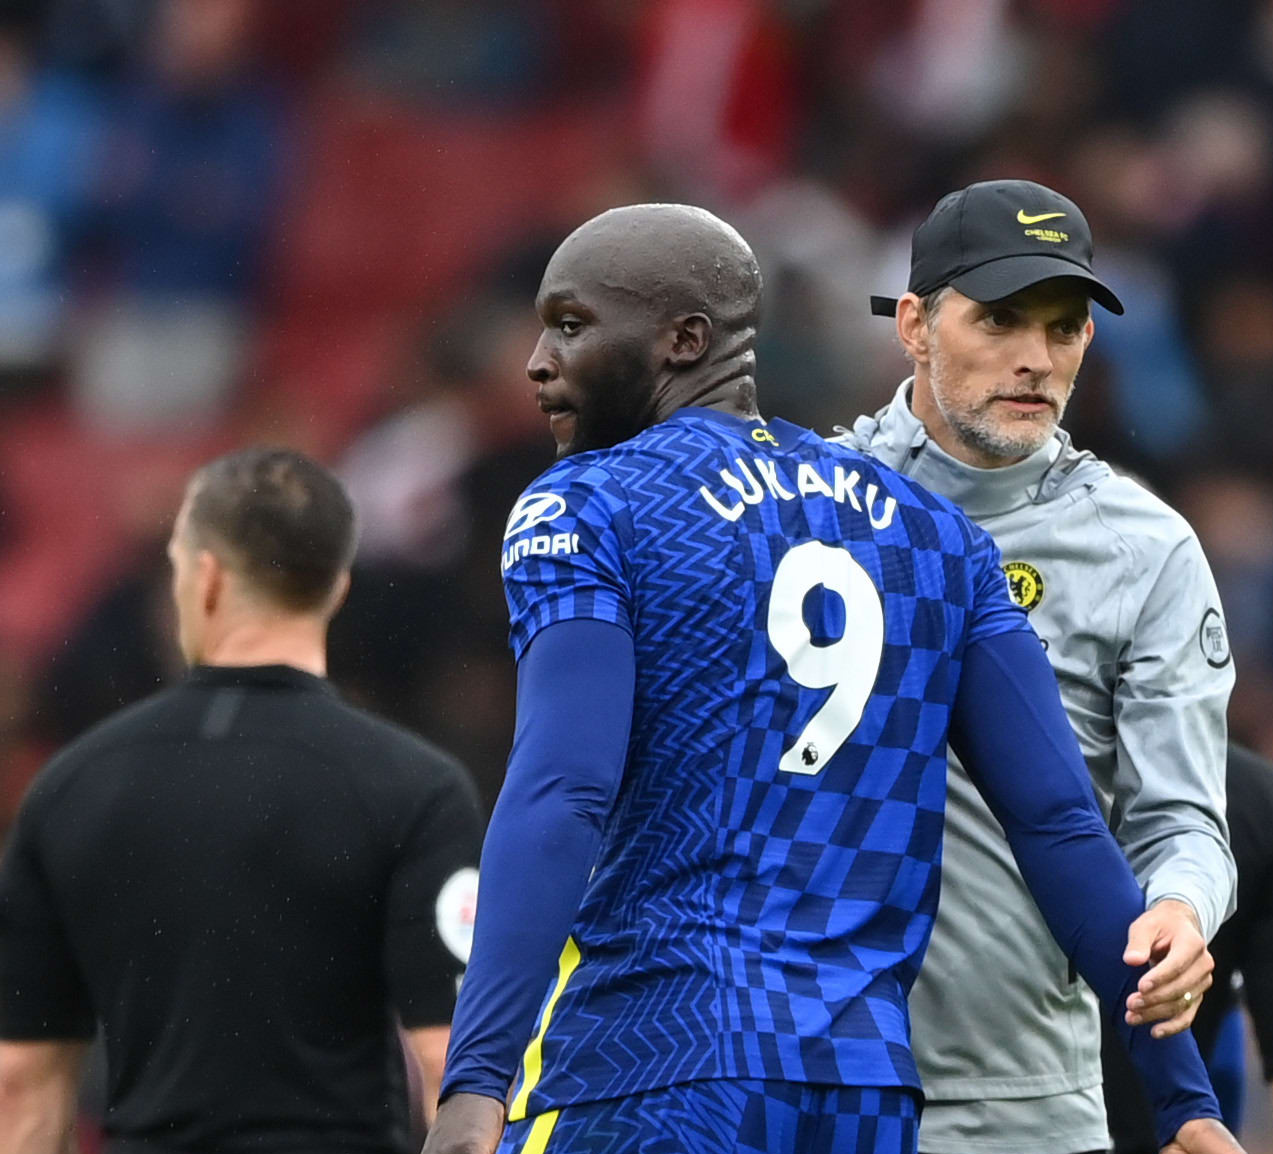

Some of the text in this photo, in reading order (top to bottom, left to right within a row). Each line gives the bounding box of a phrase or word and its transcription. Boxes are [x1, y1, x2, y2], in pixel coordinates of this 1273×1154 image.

[699, 457, 897, 530] LUKAKU
[501, 532, 580, 575] UNDAI
[767, 540, 884, 776] 9
